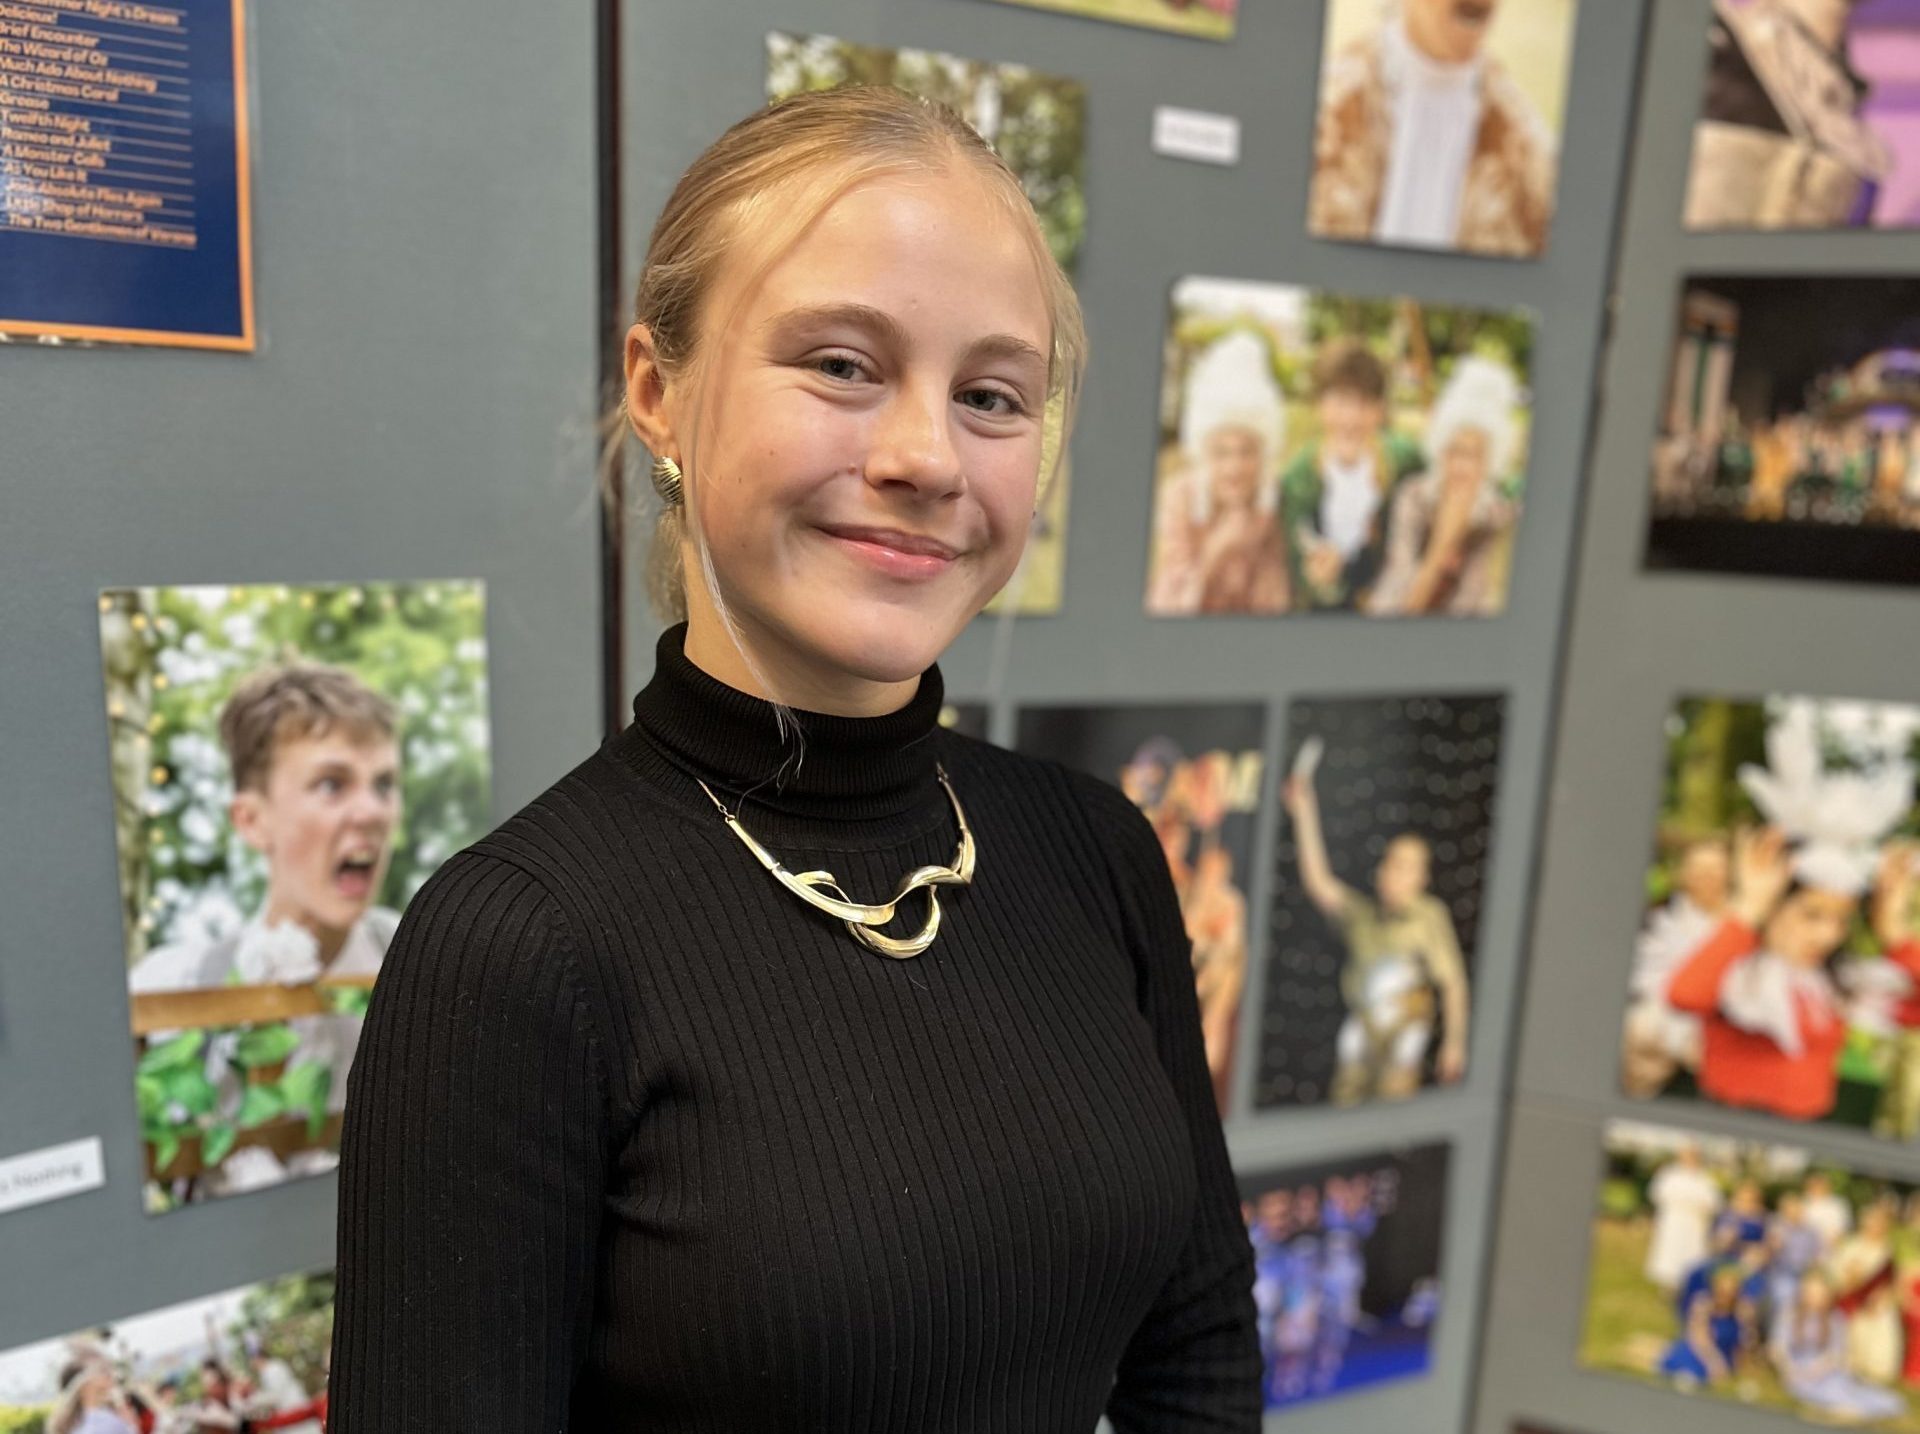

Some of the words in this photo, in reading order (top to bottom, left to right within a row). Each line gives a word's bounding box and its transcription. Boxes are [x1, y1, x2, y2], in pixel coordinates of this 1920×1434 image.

[30, 26, 100, 47] Encounter
[23, 41, 72, 60] Wizard
[72, 50, 88, 63] of
[88, 52, 109, 67] Oz
[0, 57, 35, 73] Much
[36, 61, 63, 77] Ado
[64, 65, 103, 83] About
[105, 70, 158, 94] Nothing
[0, 92, 50, 110] Grease
[11, 76, 80, 97] Christmas
[81, 84, 120, 102] Carol
[1, 109, 53, 128] Twelfth
[54, 114, 91, 133] Night
[1, 127, 49, 144] Romeo
[50, 132, 75, 147] and
[3, 144, 13, 158] A
[15, 146, 71, 164] Monster
[73, 152, 107, 169] Calls
[4, 160, 21, 175] As
[23, 163, 49, 179] You
[50, 167, 76, 182] Like
